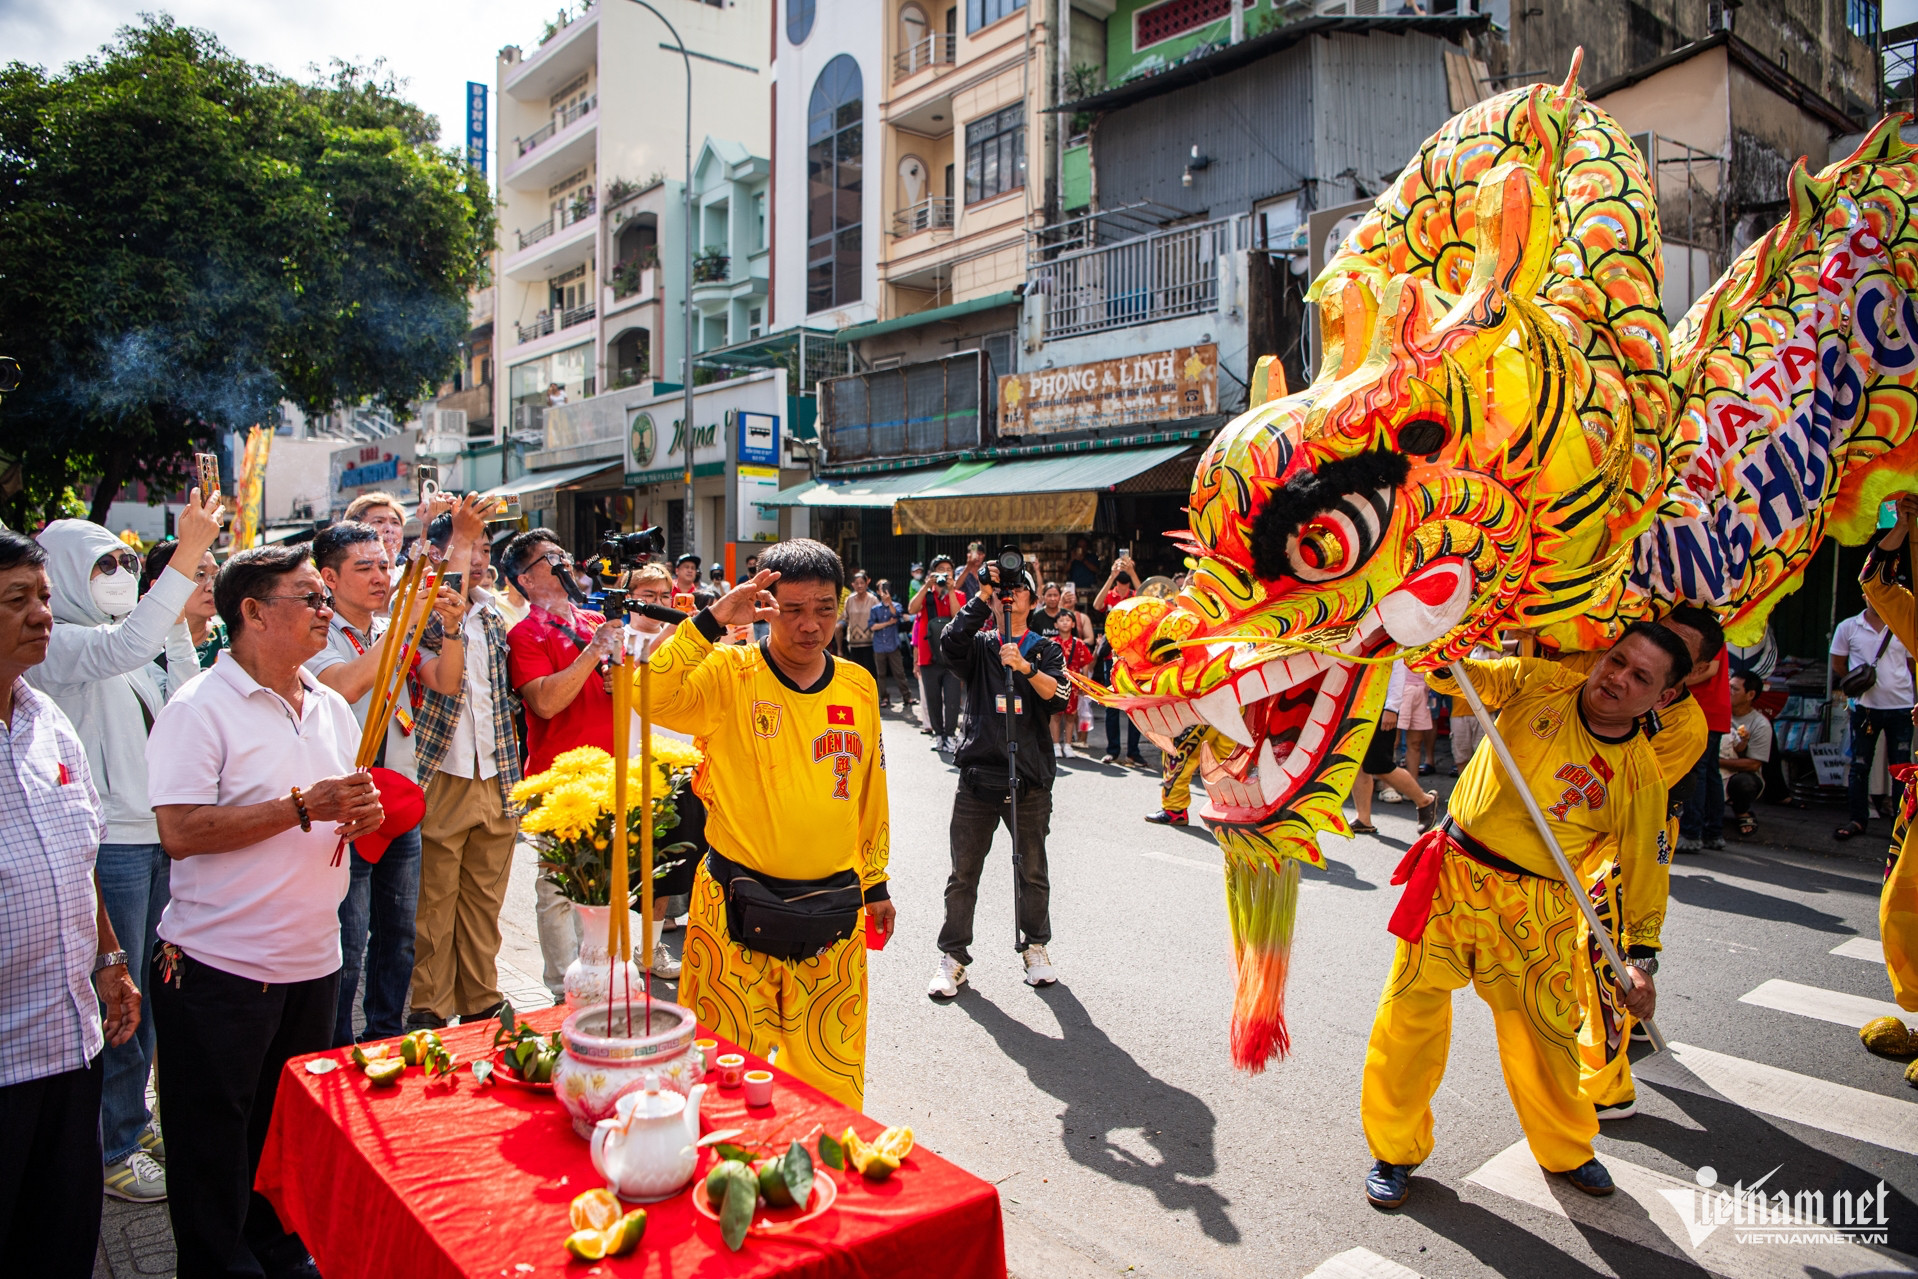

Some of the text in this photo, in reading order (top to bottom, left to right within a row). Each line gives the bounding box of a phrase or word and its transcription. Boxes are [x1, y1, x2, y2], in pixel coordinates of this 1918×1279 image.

[1029, 357, 1175, 397] PHONG & LINH
[934, 497, 1057, 523] PHONG LINH
[813, 729, 843, 762] LIÊN
[1555, 764, 1594, 790] LIÊN
